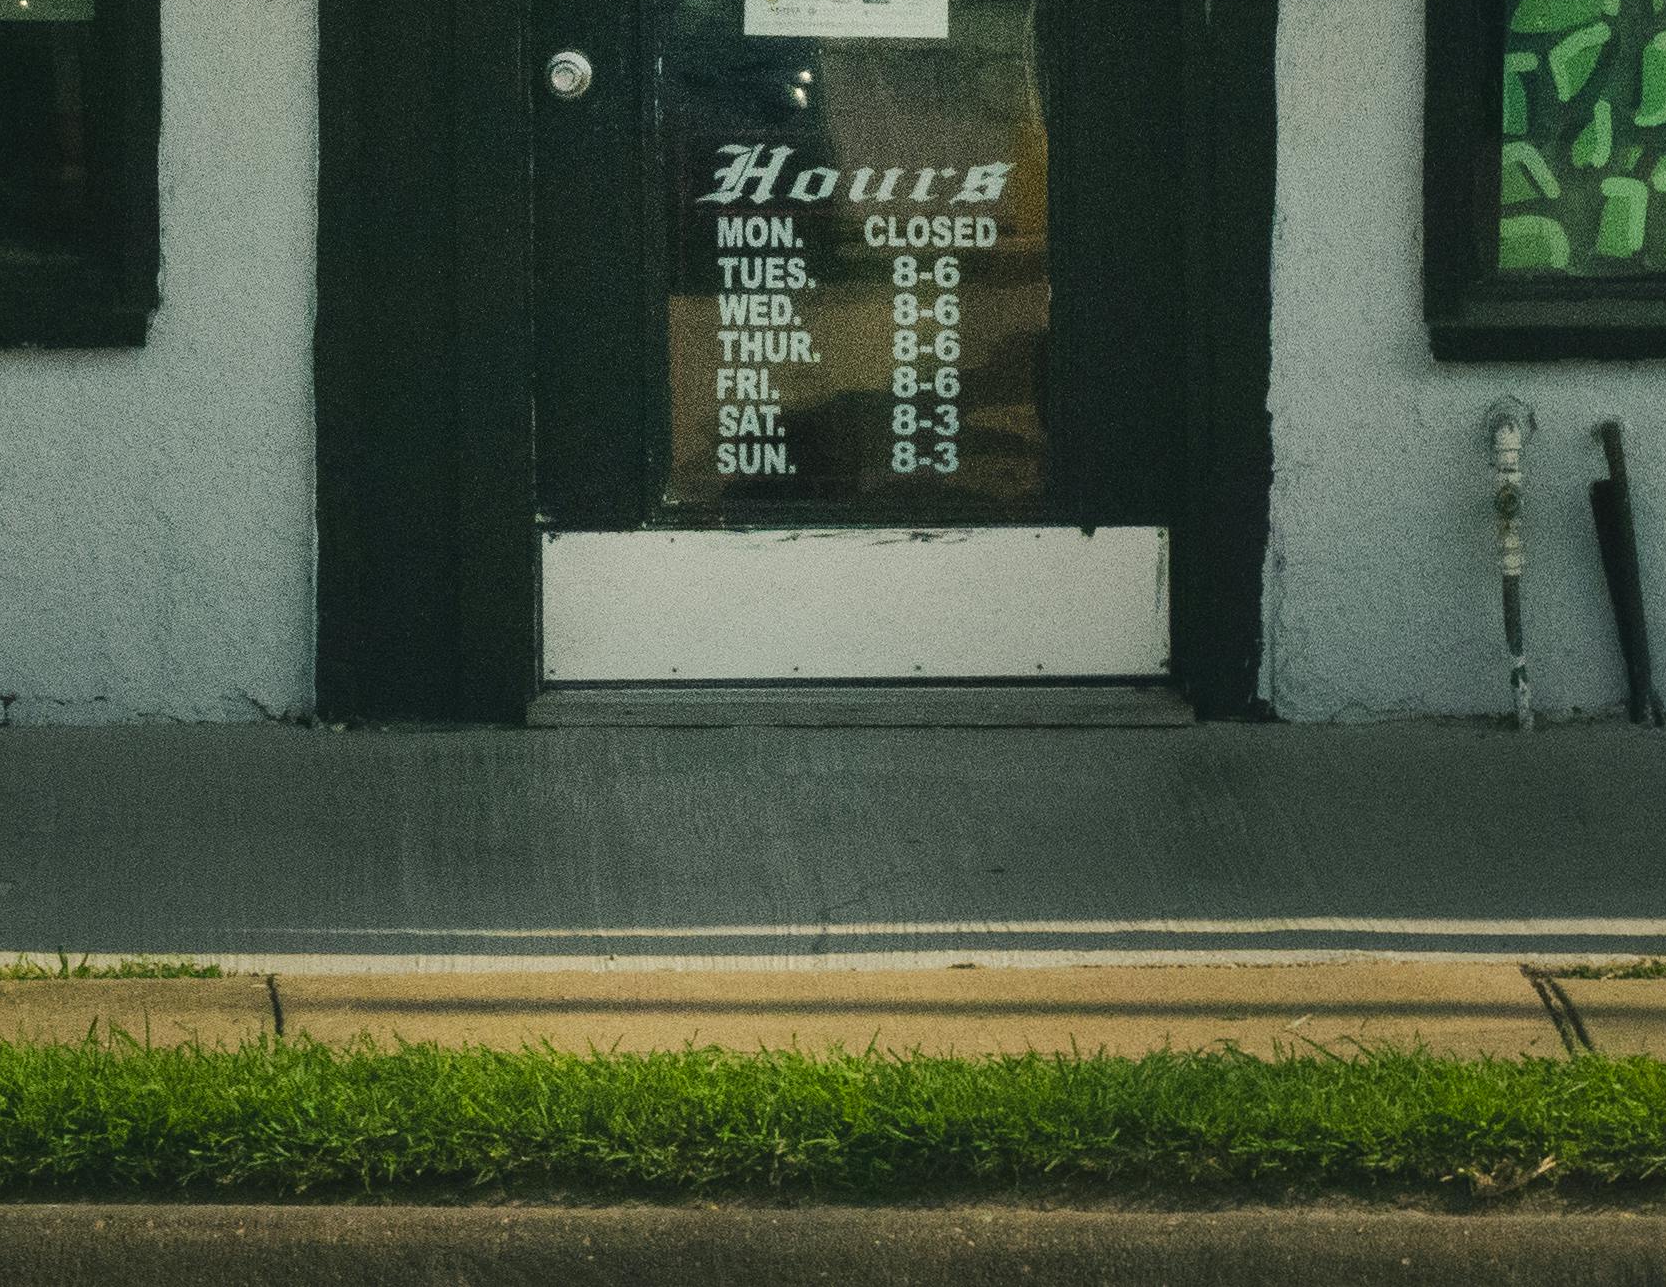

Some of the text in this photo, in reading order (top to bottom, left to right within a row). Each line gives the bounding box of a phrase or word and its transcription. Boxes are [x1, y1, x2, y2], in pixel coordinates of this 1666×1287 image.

[696, 143, 1016, 205] Hours
[717, 216, 997, 248] MON. CLOSED
[718, 255, 960, 289] TUES. 8-6
[718, 292, 960, 326] WED. 8-6
[718, 329, 960, 363] THUR. 8-6
[716, 366, 960, 401] FRI. 8-6
[718, 403, 960, 438] SAT. 8-3
[717, 440, 960, 475] SUN. 8-3
